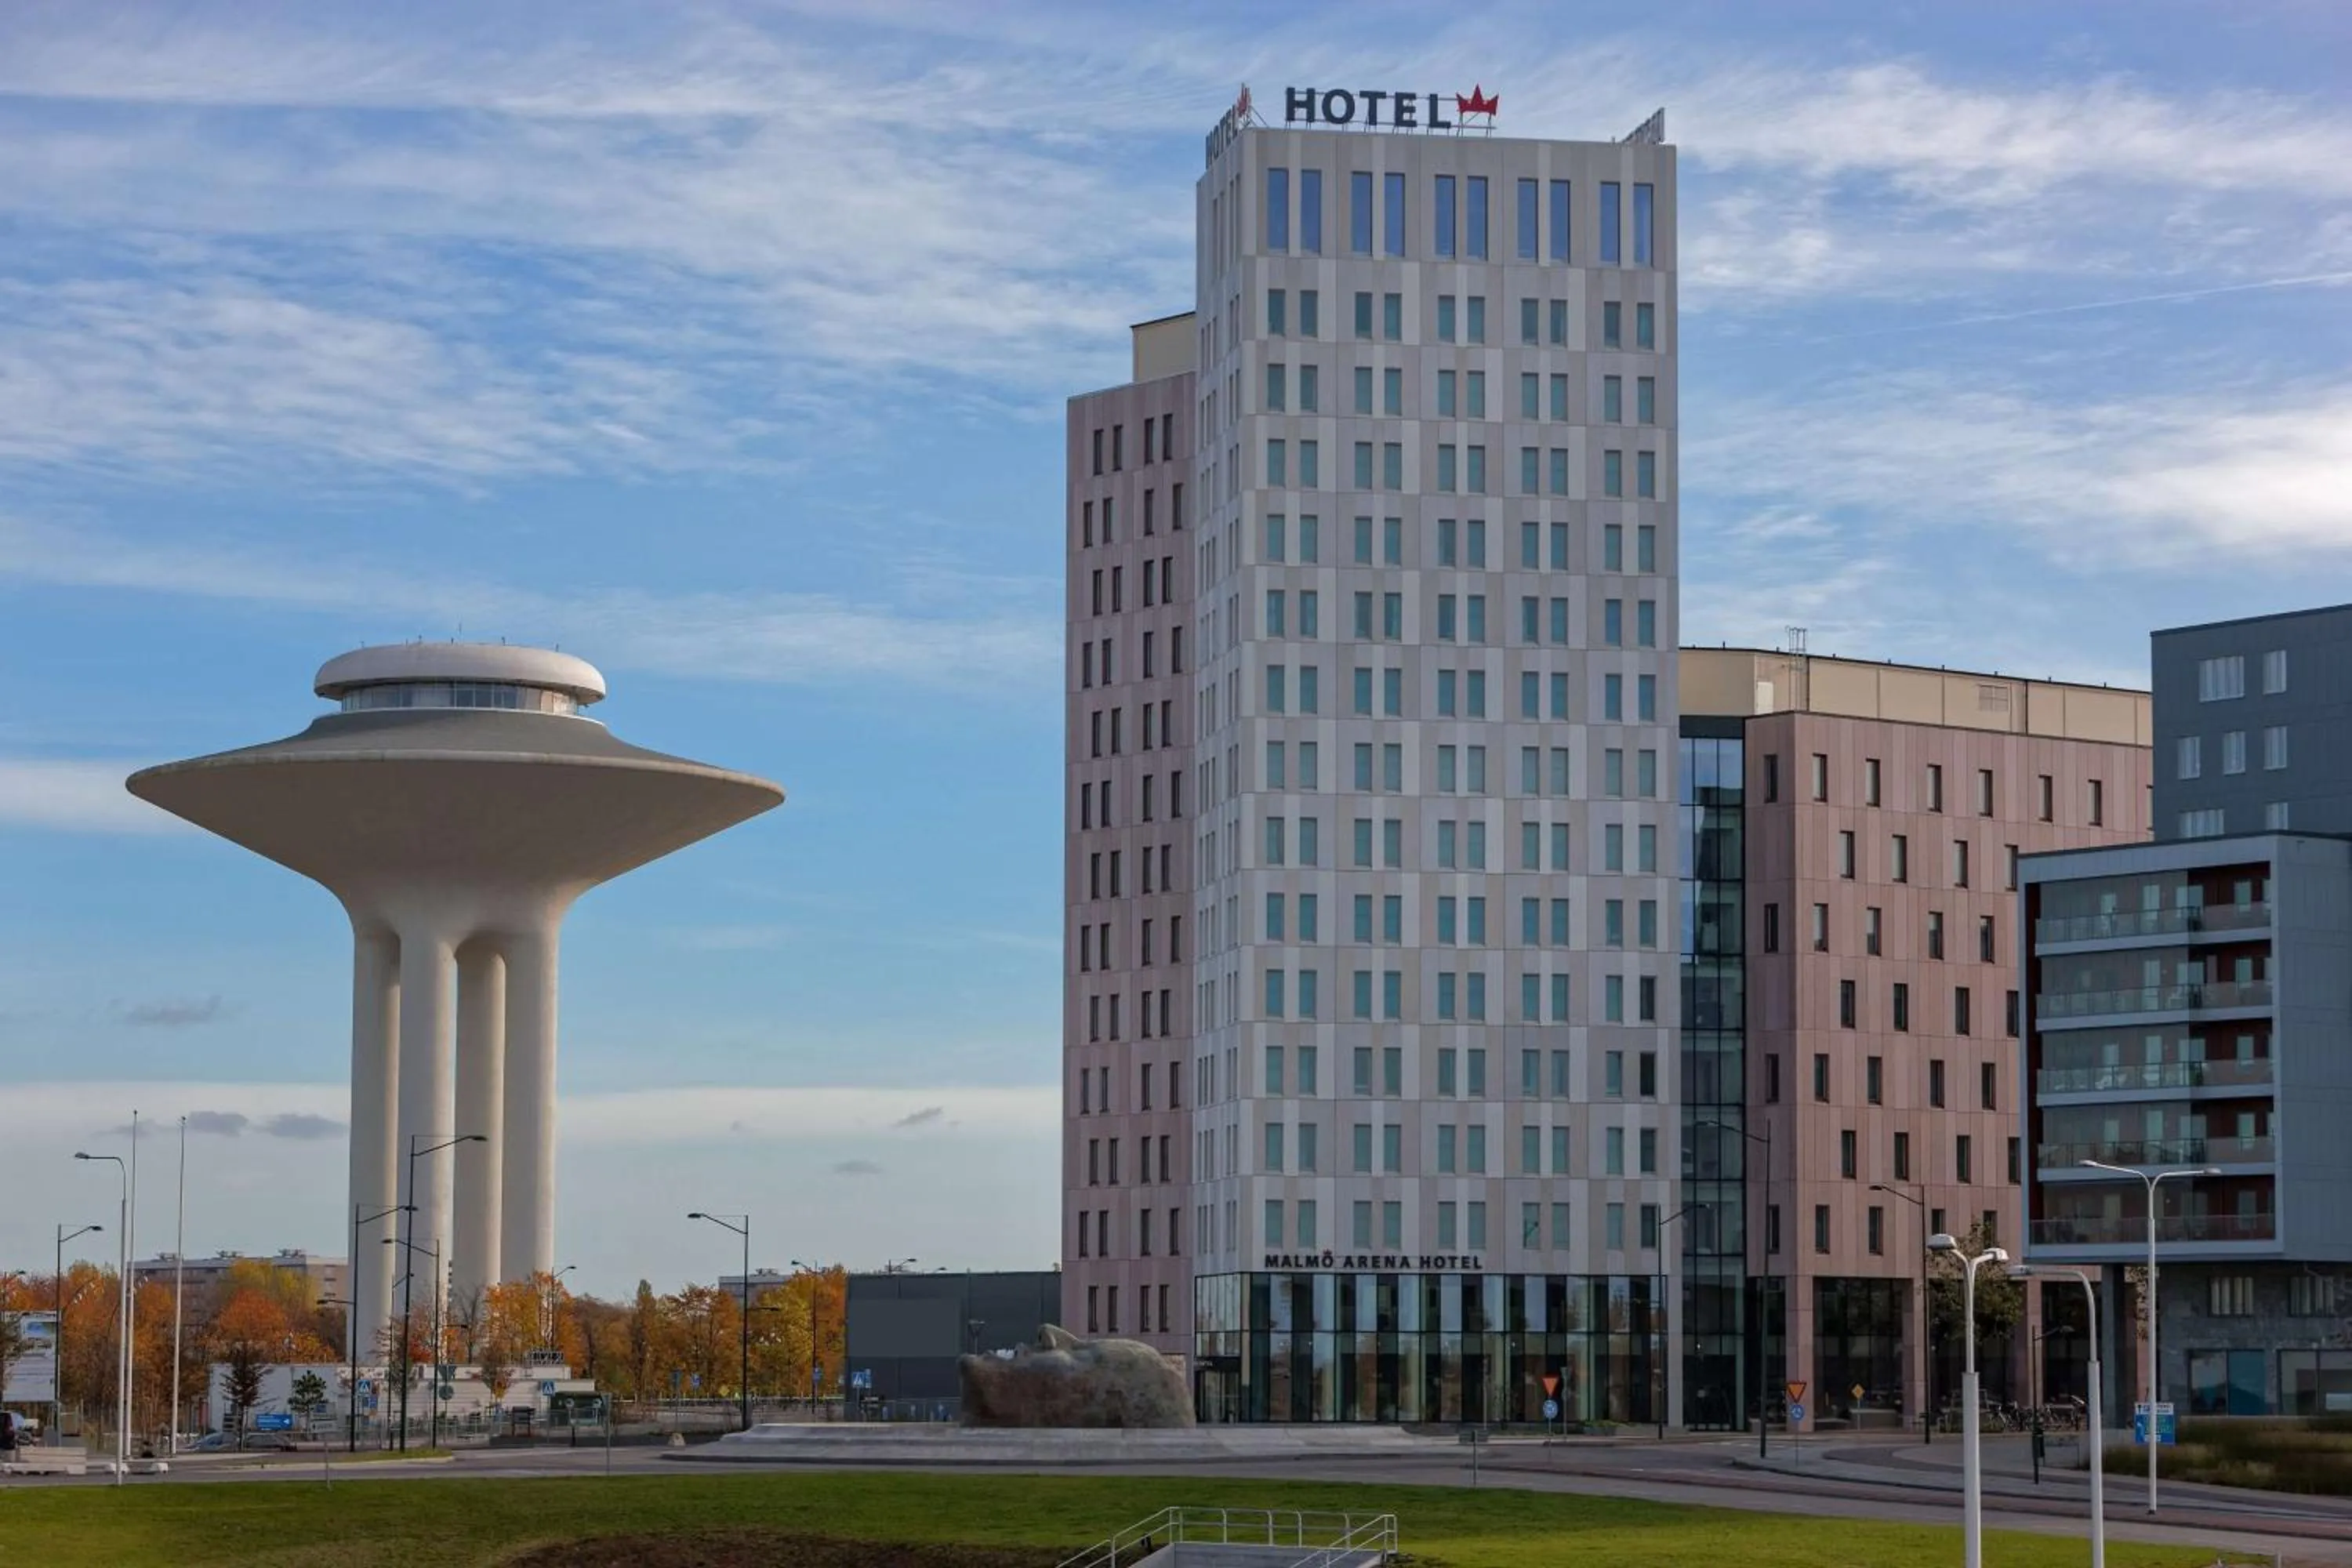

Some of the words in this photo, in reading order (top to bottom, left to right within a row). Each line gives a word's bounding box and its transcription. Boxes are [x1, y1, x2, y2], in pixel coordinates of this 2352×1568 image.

[1286, 87, 1450, 129] HOTEL
[1206, 103, 1238, 170] HOTEL
[1265, 1250, 1333, 1268] MALMÖ
[1343, 1255, 1410, 1269] ARENA
[1420, 1256, 1483, 1269] HOTEL
